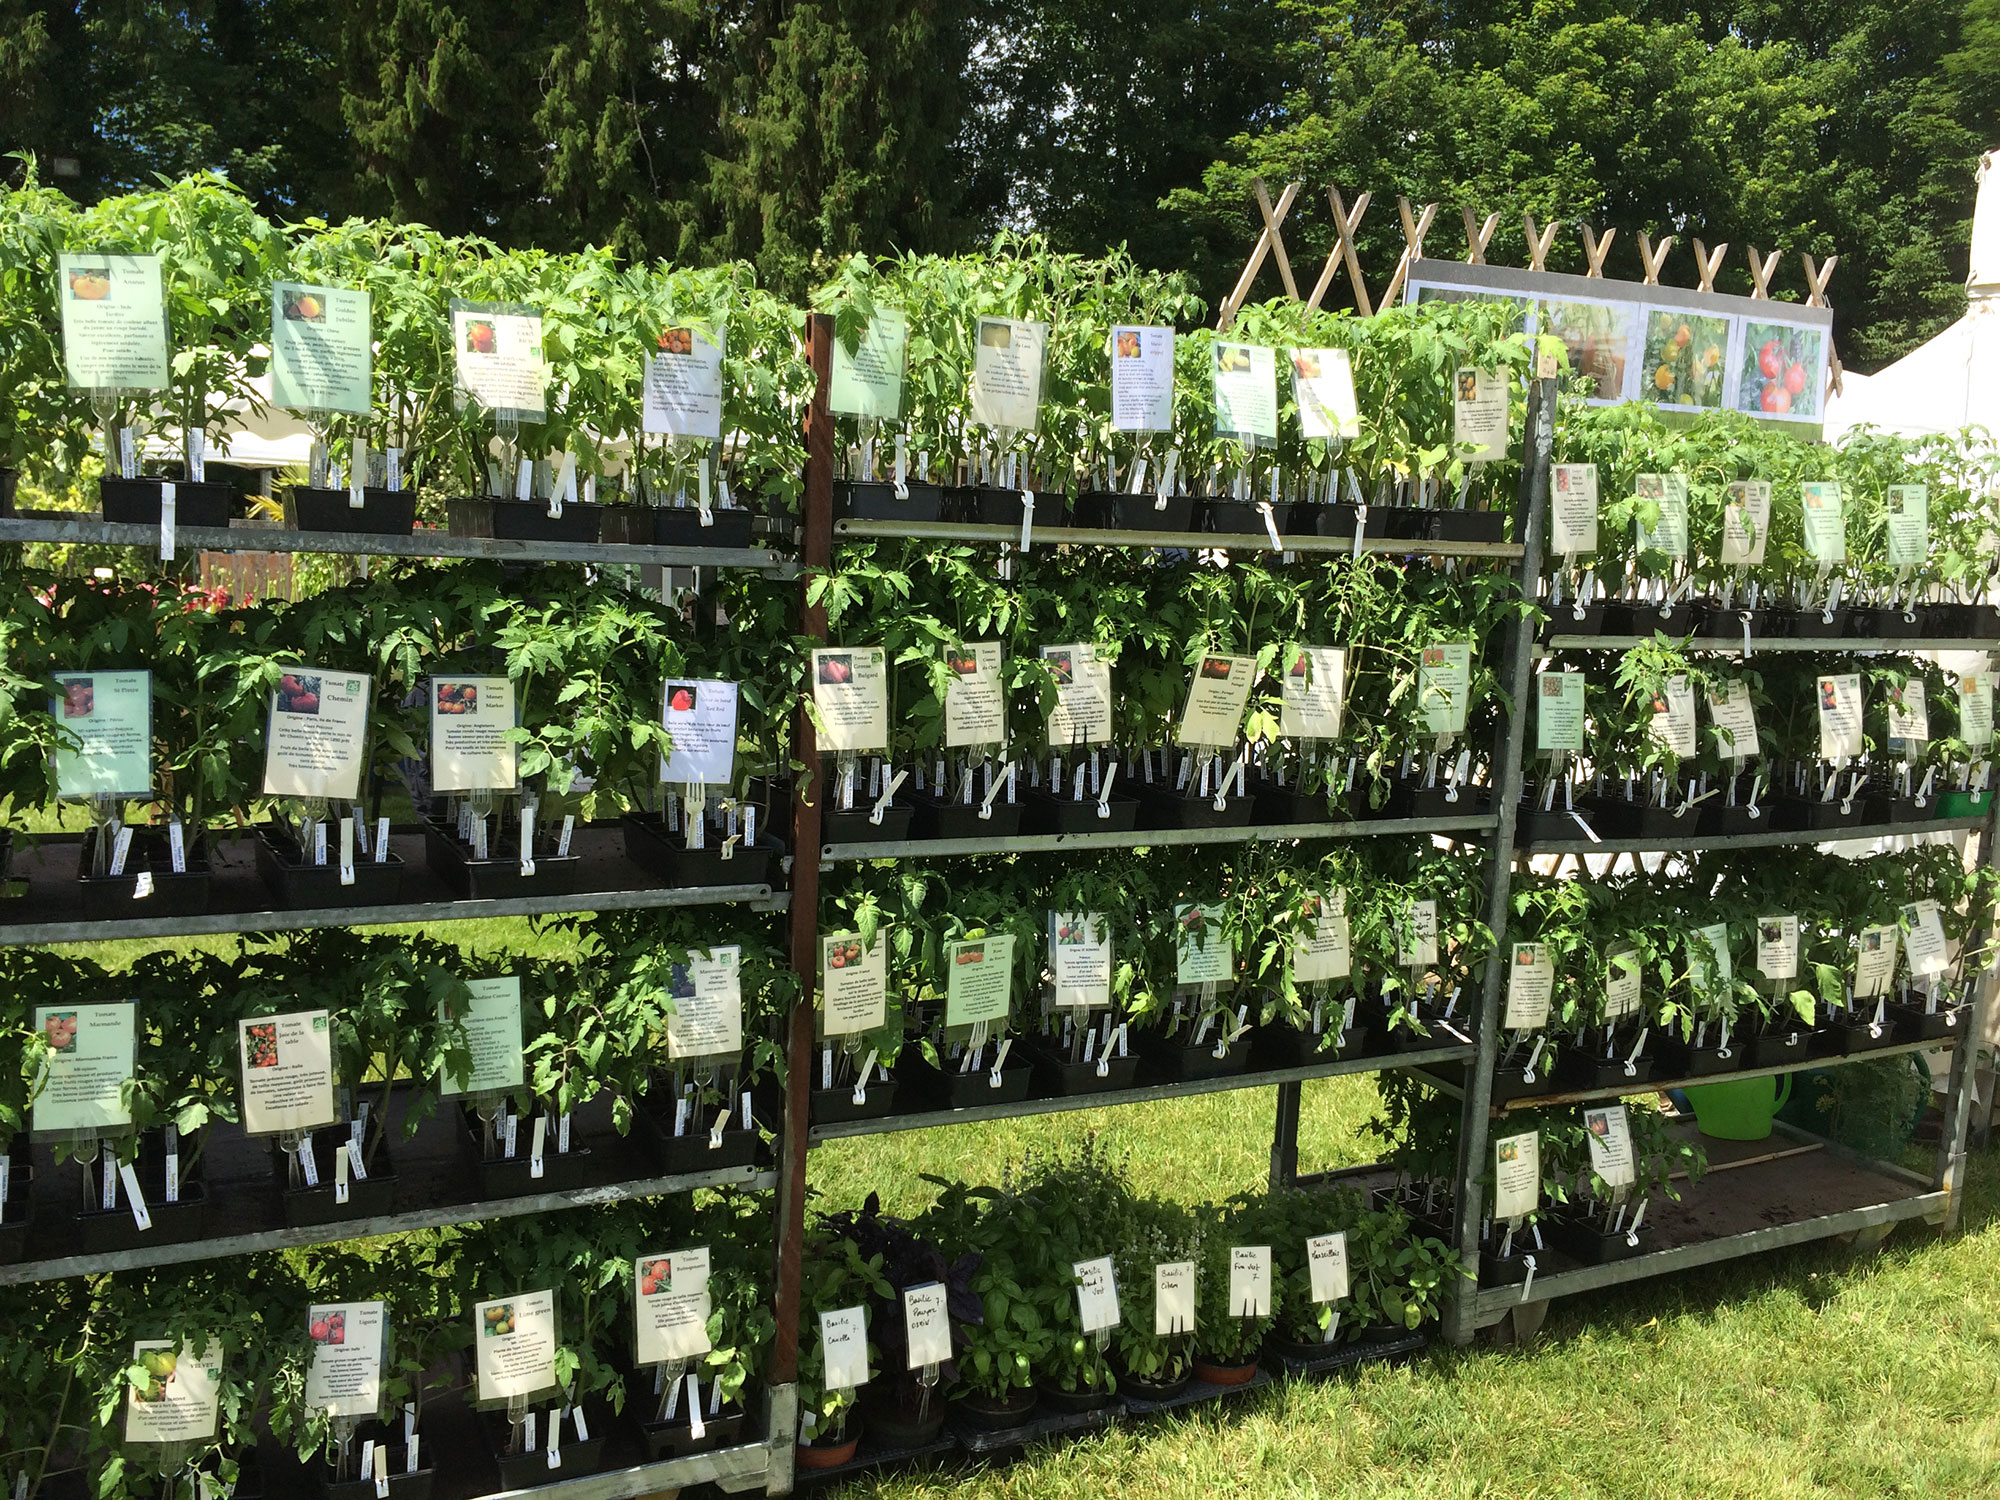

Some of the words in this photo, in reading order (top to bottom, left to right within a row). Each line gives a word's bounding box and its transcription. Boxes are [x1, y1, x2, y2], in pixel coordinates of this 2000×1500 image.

[1080, 1266, 1101, 1277] Basilic
[1161, 1268, 1184, 1277] Basilic
[909, 1294, 931, 1306] Basilic
[535, 1308, 551, 1316] green
[827, 1318, 849, 1328] Basilic
